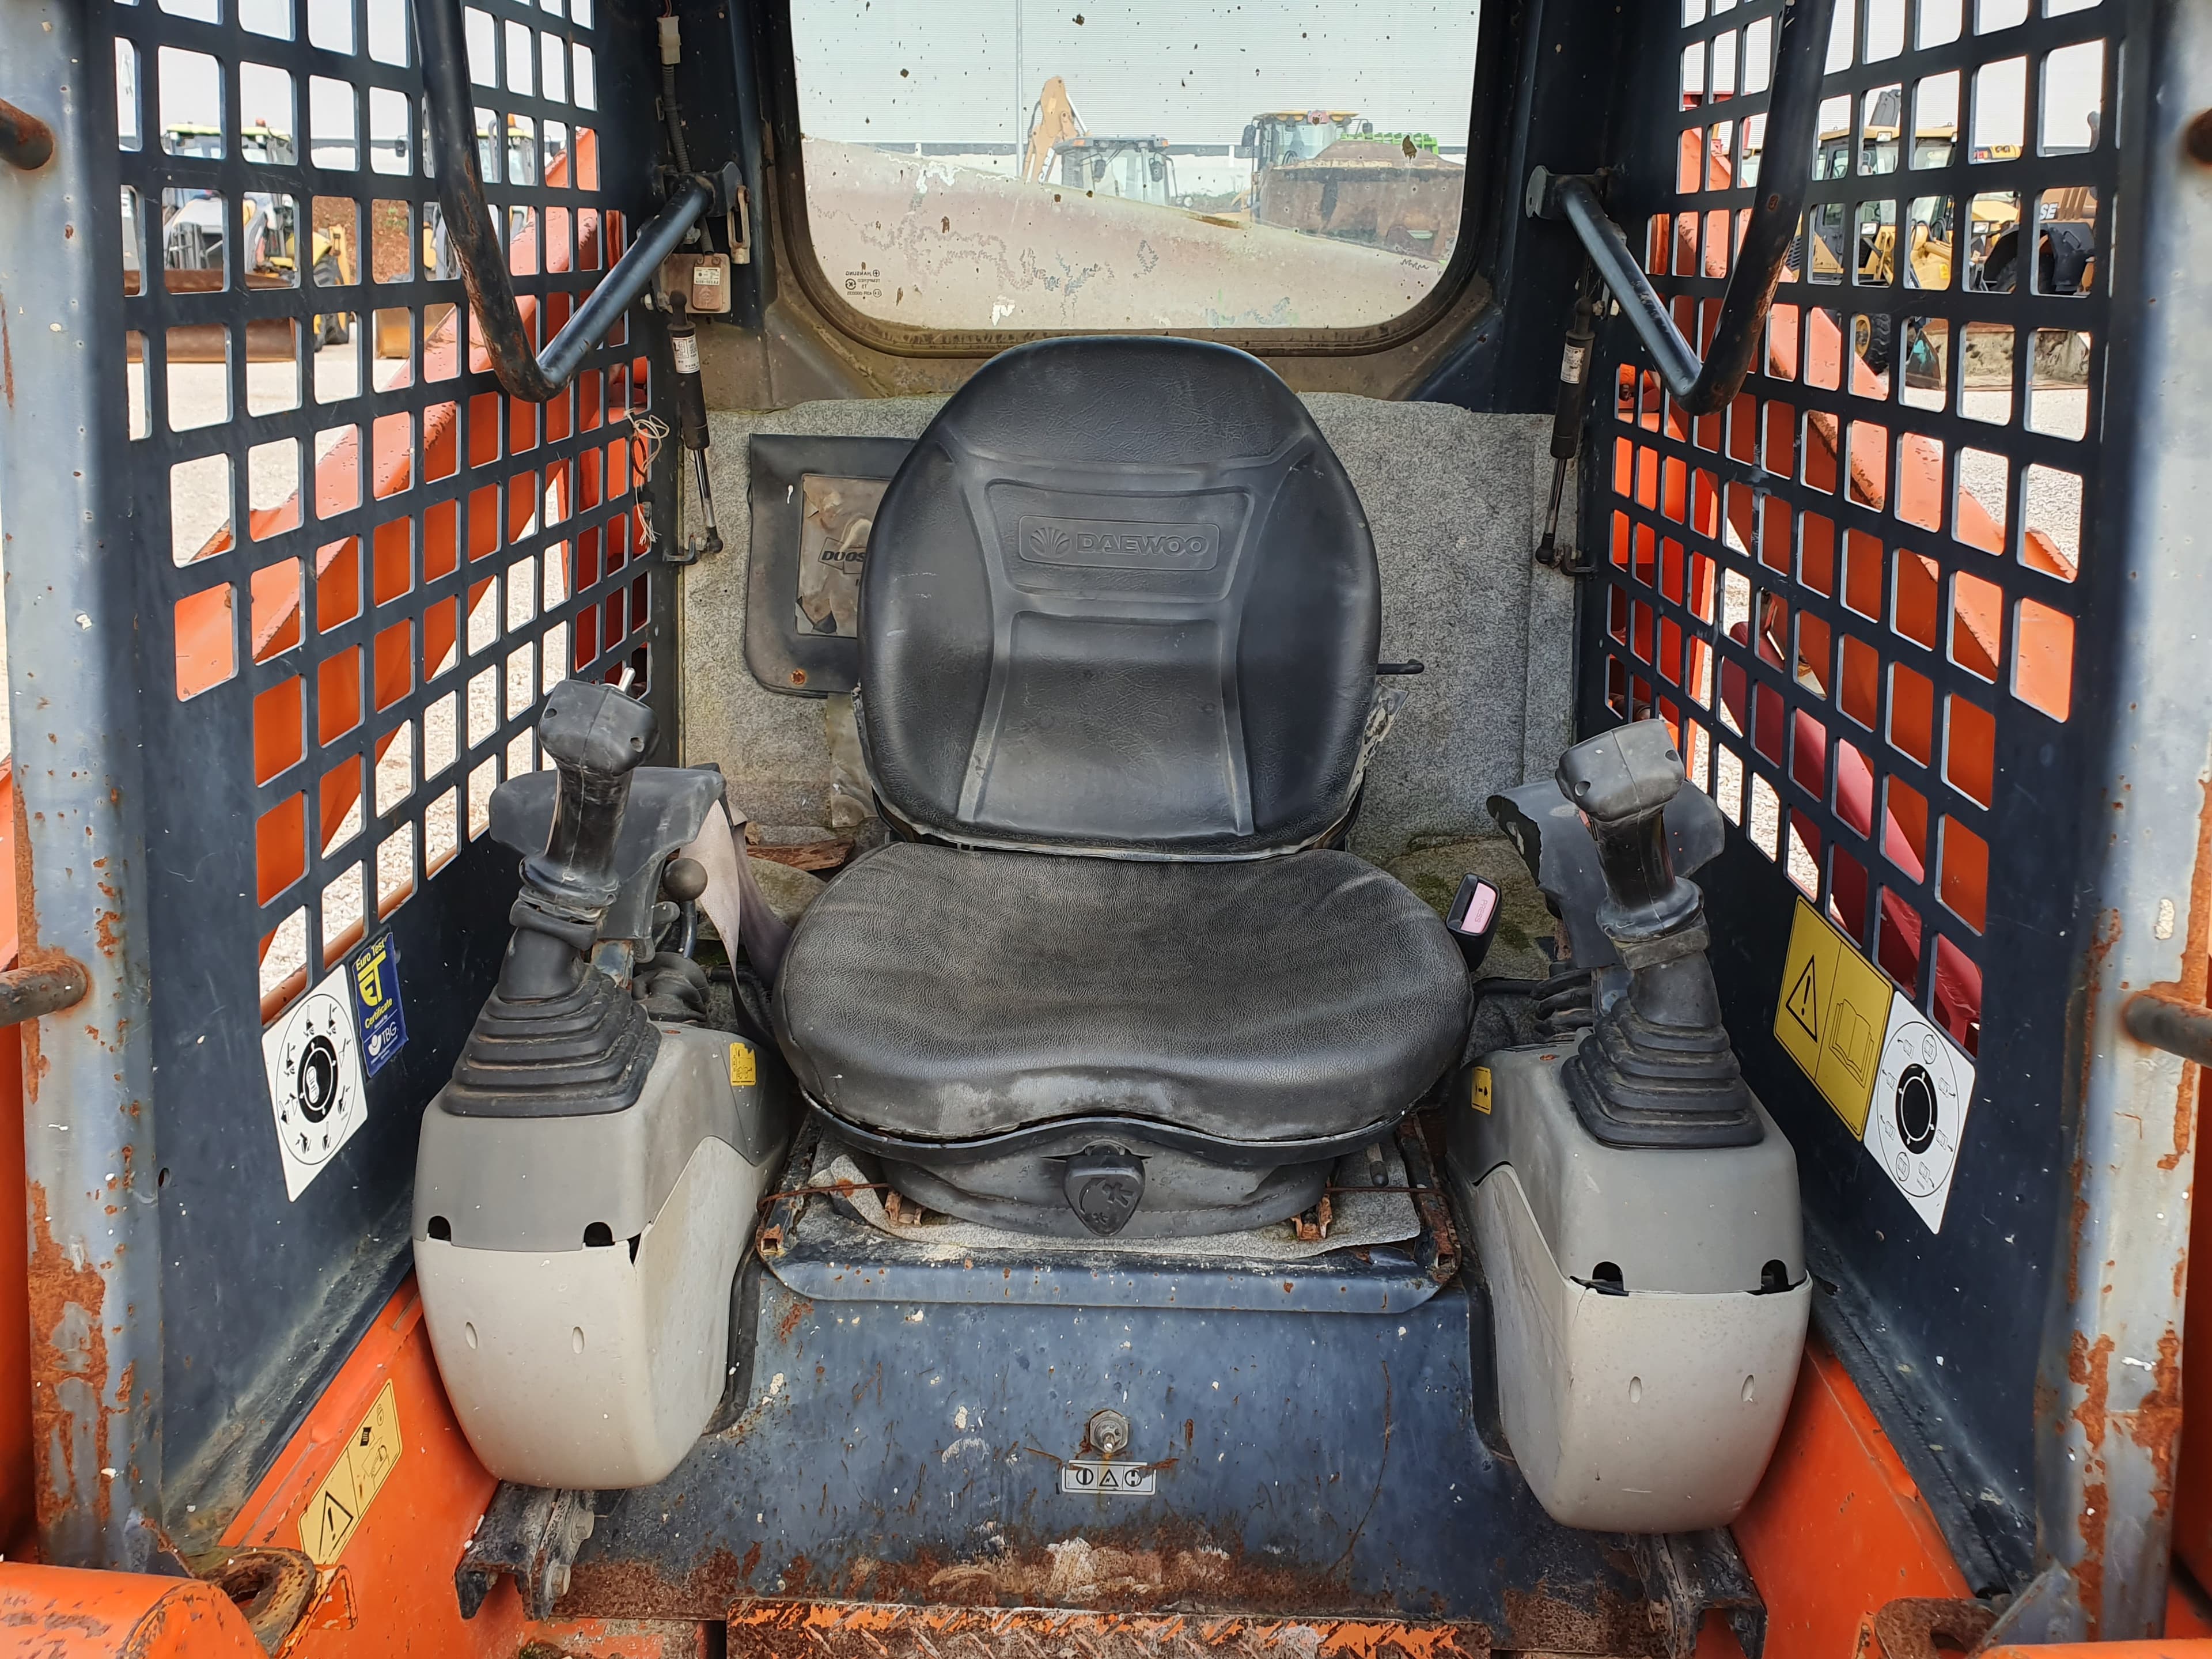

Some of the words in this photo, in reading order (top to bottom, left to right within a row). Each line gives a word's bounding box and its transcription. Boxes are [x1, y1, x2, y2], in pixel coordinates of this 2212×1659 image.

[2040, 202, 2059, 221] SE
[821, 551, 867, 562] DOOS
[1077, 532, 1209, 558] DAEWOO
[1475, 899, 1488, 922] PRESS
[356, 953, 371, 971] Euro
[371, 939, 385, 956] Test
[365, 998, 393, 1029] Certificate
[381, 1021, 397, 1044] TBG
